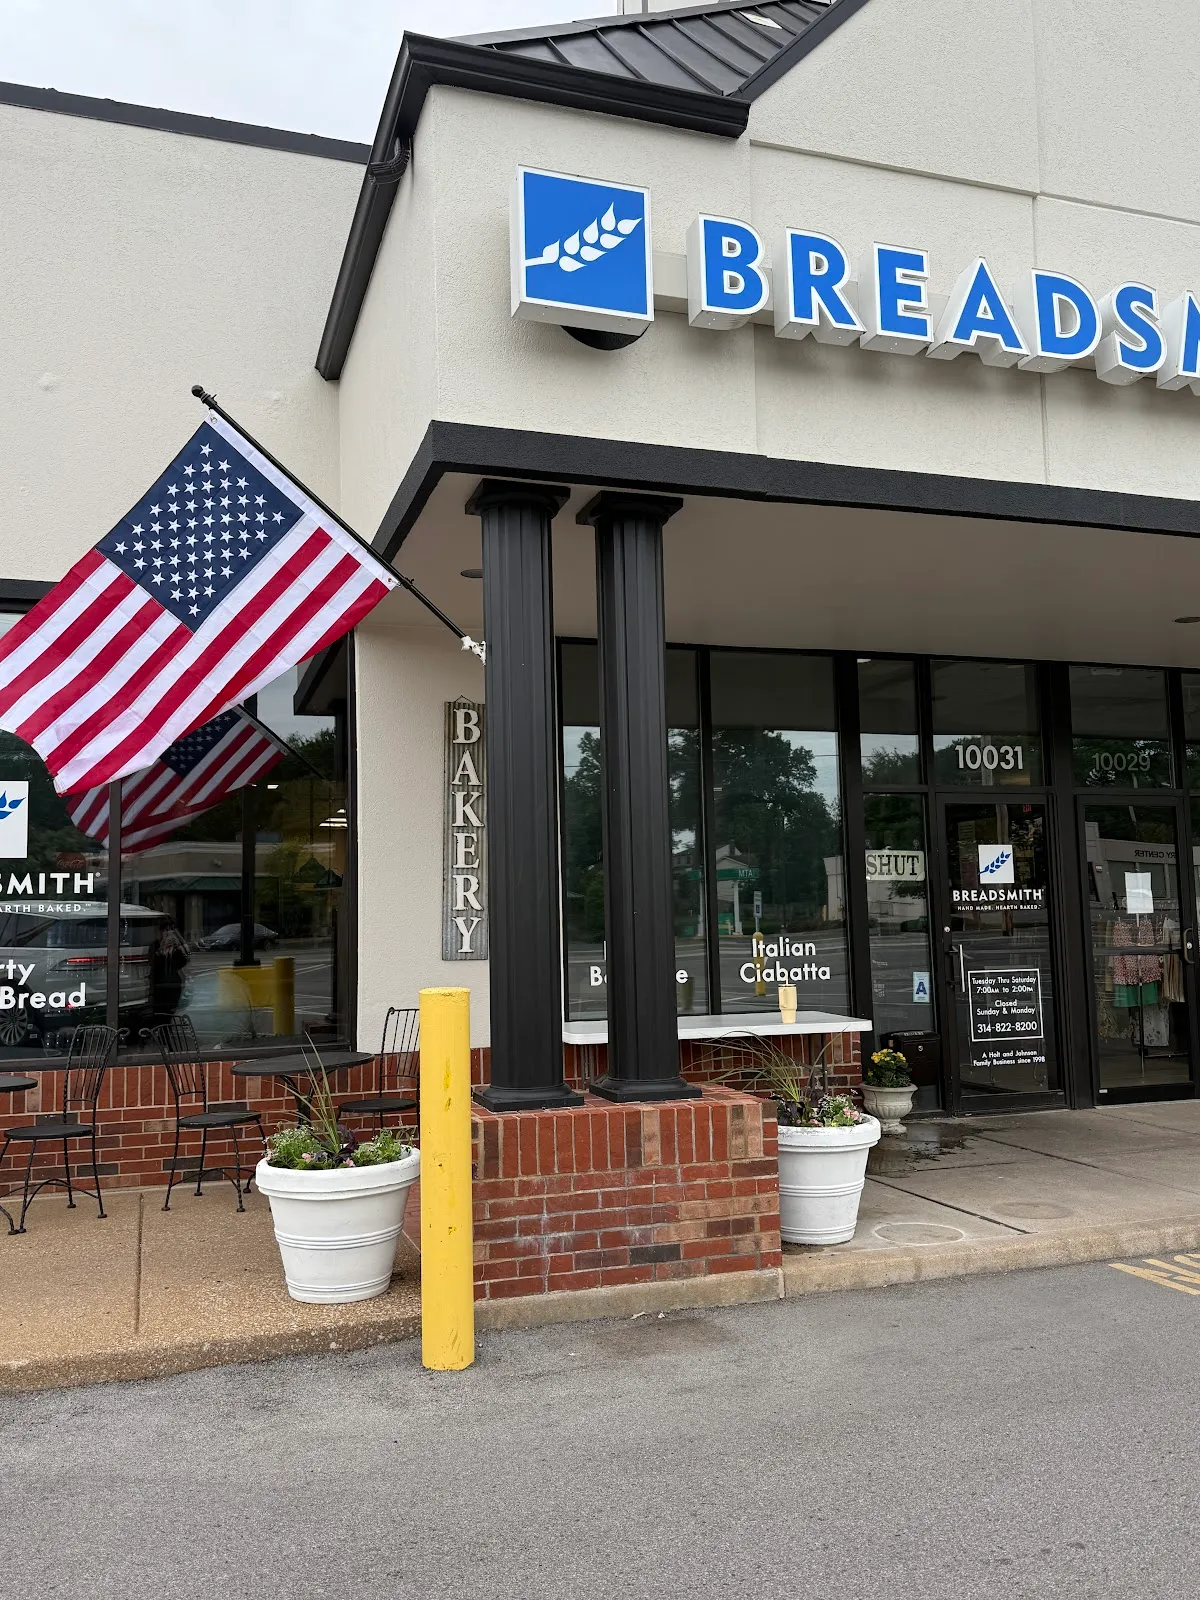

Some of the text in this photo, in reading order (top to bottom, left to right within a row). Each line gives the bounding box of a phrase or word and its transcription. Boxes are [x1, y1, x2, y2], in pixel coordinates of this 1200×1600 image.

[698, 212, 1200, 379] BREADS
[955, 745, 1024, 770] 10031
[1092, 752, 1151, 771] 10029
[451, 708, 485, 953] BAKERY
[866, 854, 920, 876] SHUT
[0, 872, 94, 895] MITH
[952, 889, 1042, 902] BREADSMITH
[0, 904, 31, 913] RTH
[752, 936, 816, 957] Italian
[740, 960, 831, 983] Ciabatta
[915, 981, 928, 995] A
[971, 975, 1037, 986] Tuesday Thru Saturday
[0, 982, 86, 1010] Bread
[994, 999, 1018, 1007] Closed
[976, 1006, 1036, 1016] Sunday & Monday
[977, 1021, 1038, 1033] 314-822-8200
[988, 1050, 1000, 1058] Holt
[973, 1059, 992, 1067] Family
[992, 1058, 1016, 1066] Business
